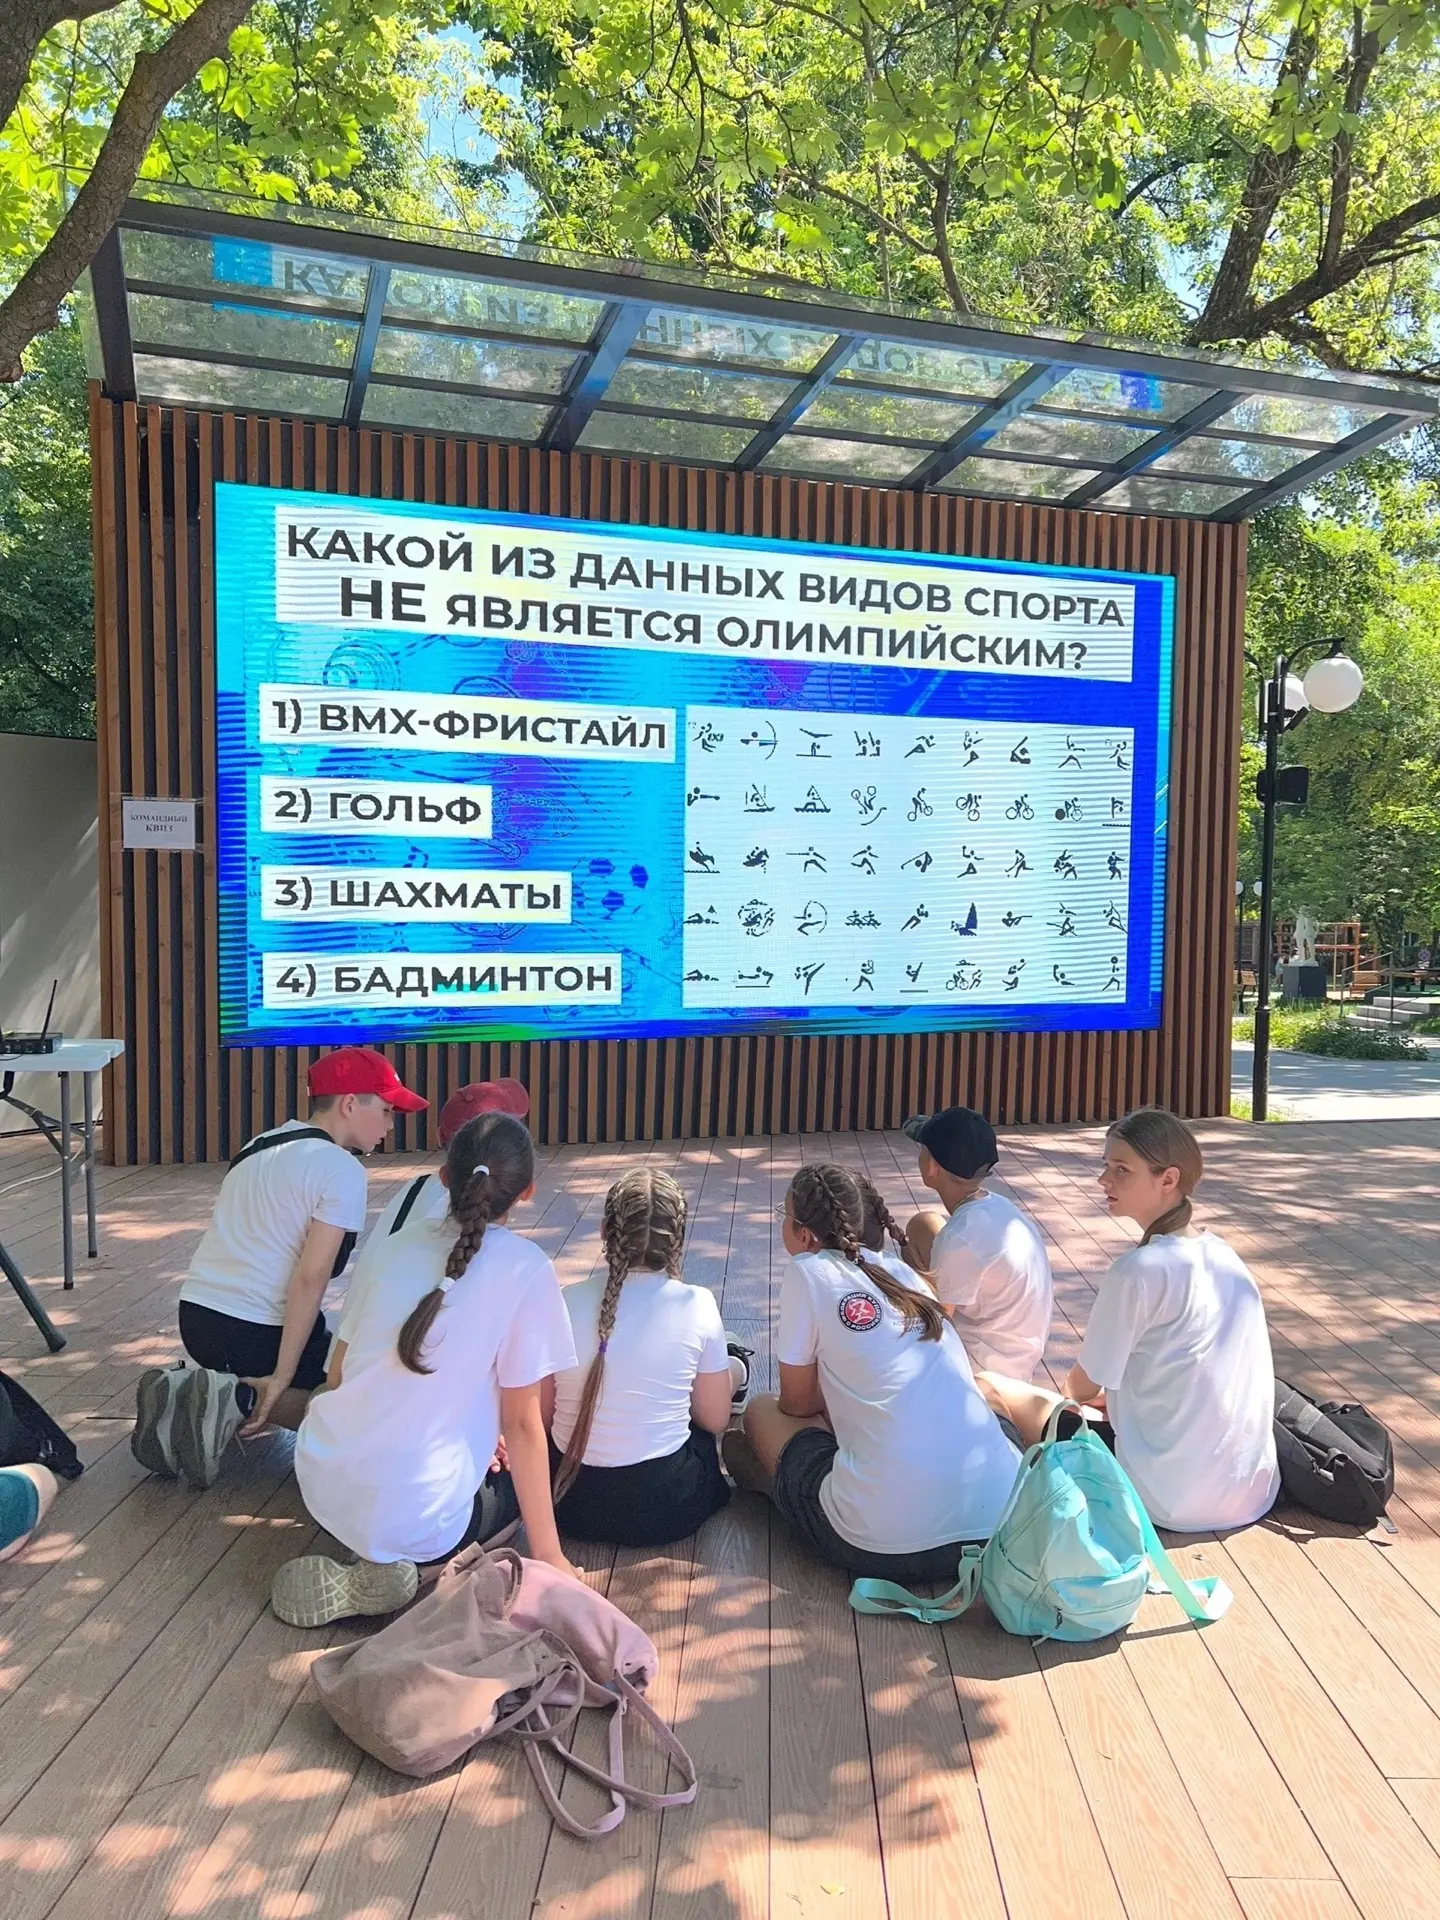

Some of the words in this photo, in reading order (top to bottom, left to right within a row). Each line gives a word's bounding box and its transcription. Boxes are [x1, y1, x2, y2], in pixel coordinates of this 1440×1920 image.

[287, 524, 474, 572] КАКОЙ
[492, 543, 556, 579] ИЗ
[569, 551, 785, 599] ДАННЫХ
[799, 572, 952, 614] ВИДОВ
[964, 587, 1125, 627] СПОРТА
[340, 577, 426, 623] НЕ
[446, 594, 702, 644] ЯВЛЯЕТСЯ
[717, 616, 1088, 670] ОЛИМПИЙСКИМ?
[272, 699, 302, 734] 1)
[274, 788, 312, 823] 2)
[329, 792, 481, 825] ГОЛЬФ
[145, 824, 173, 833] КВИЗ
[274, 876, 313, 911] 3)
[330, 879, 562, 909] ШАХМАТЫ
[276, 963, 316, 996] 4)
[334, 966, 612, 998] БАДМИНТОН
